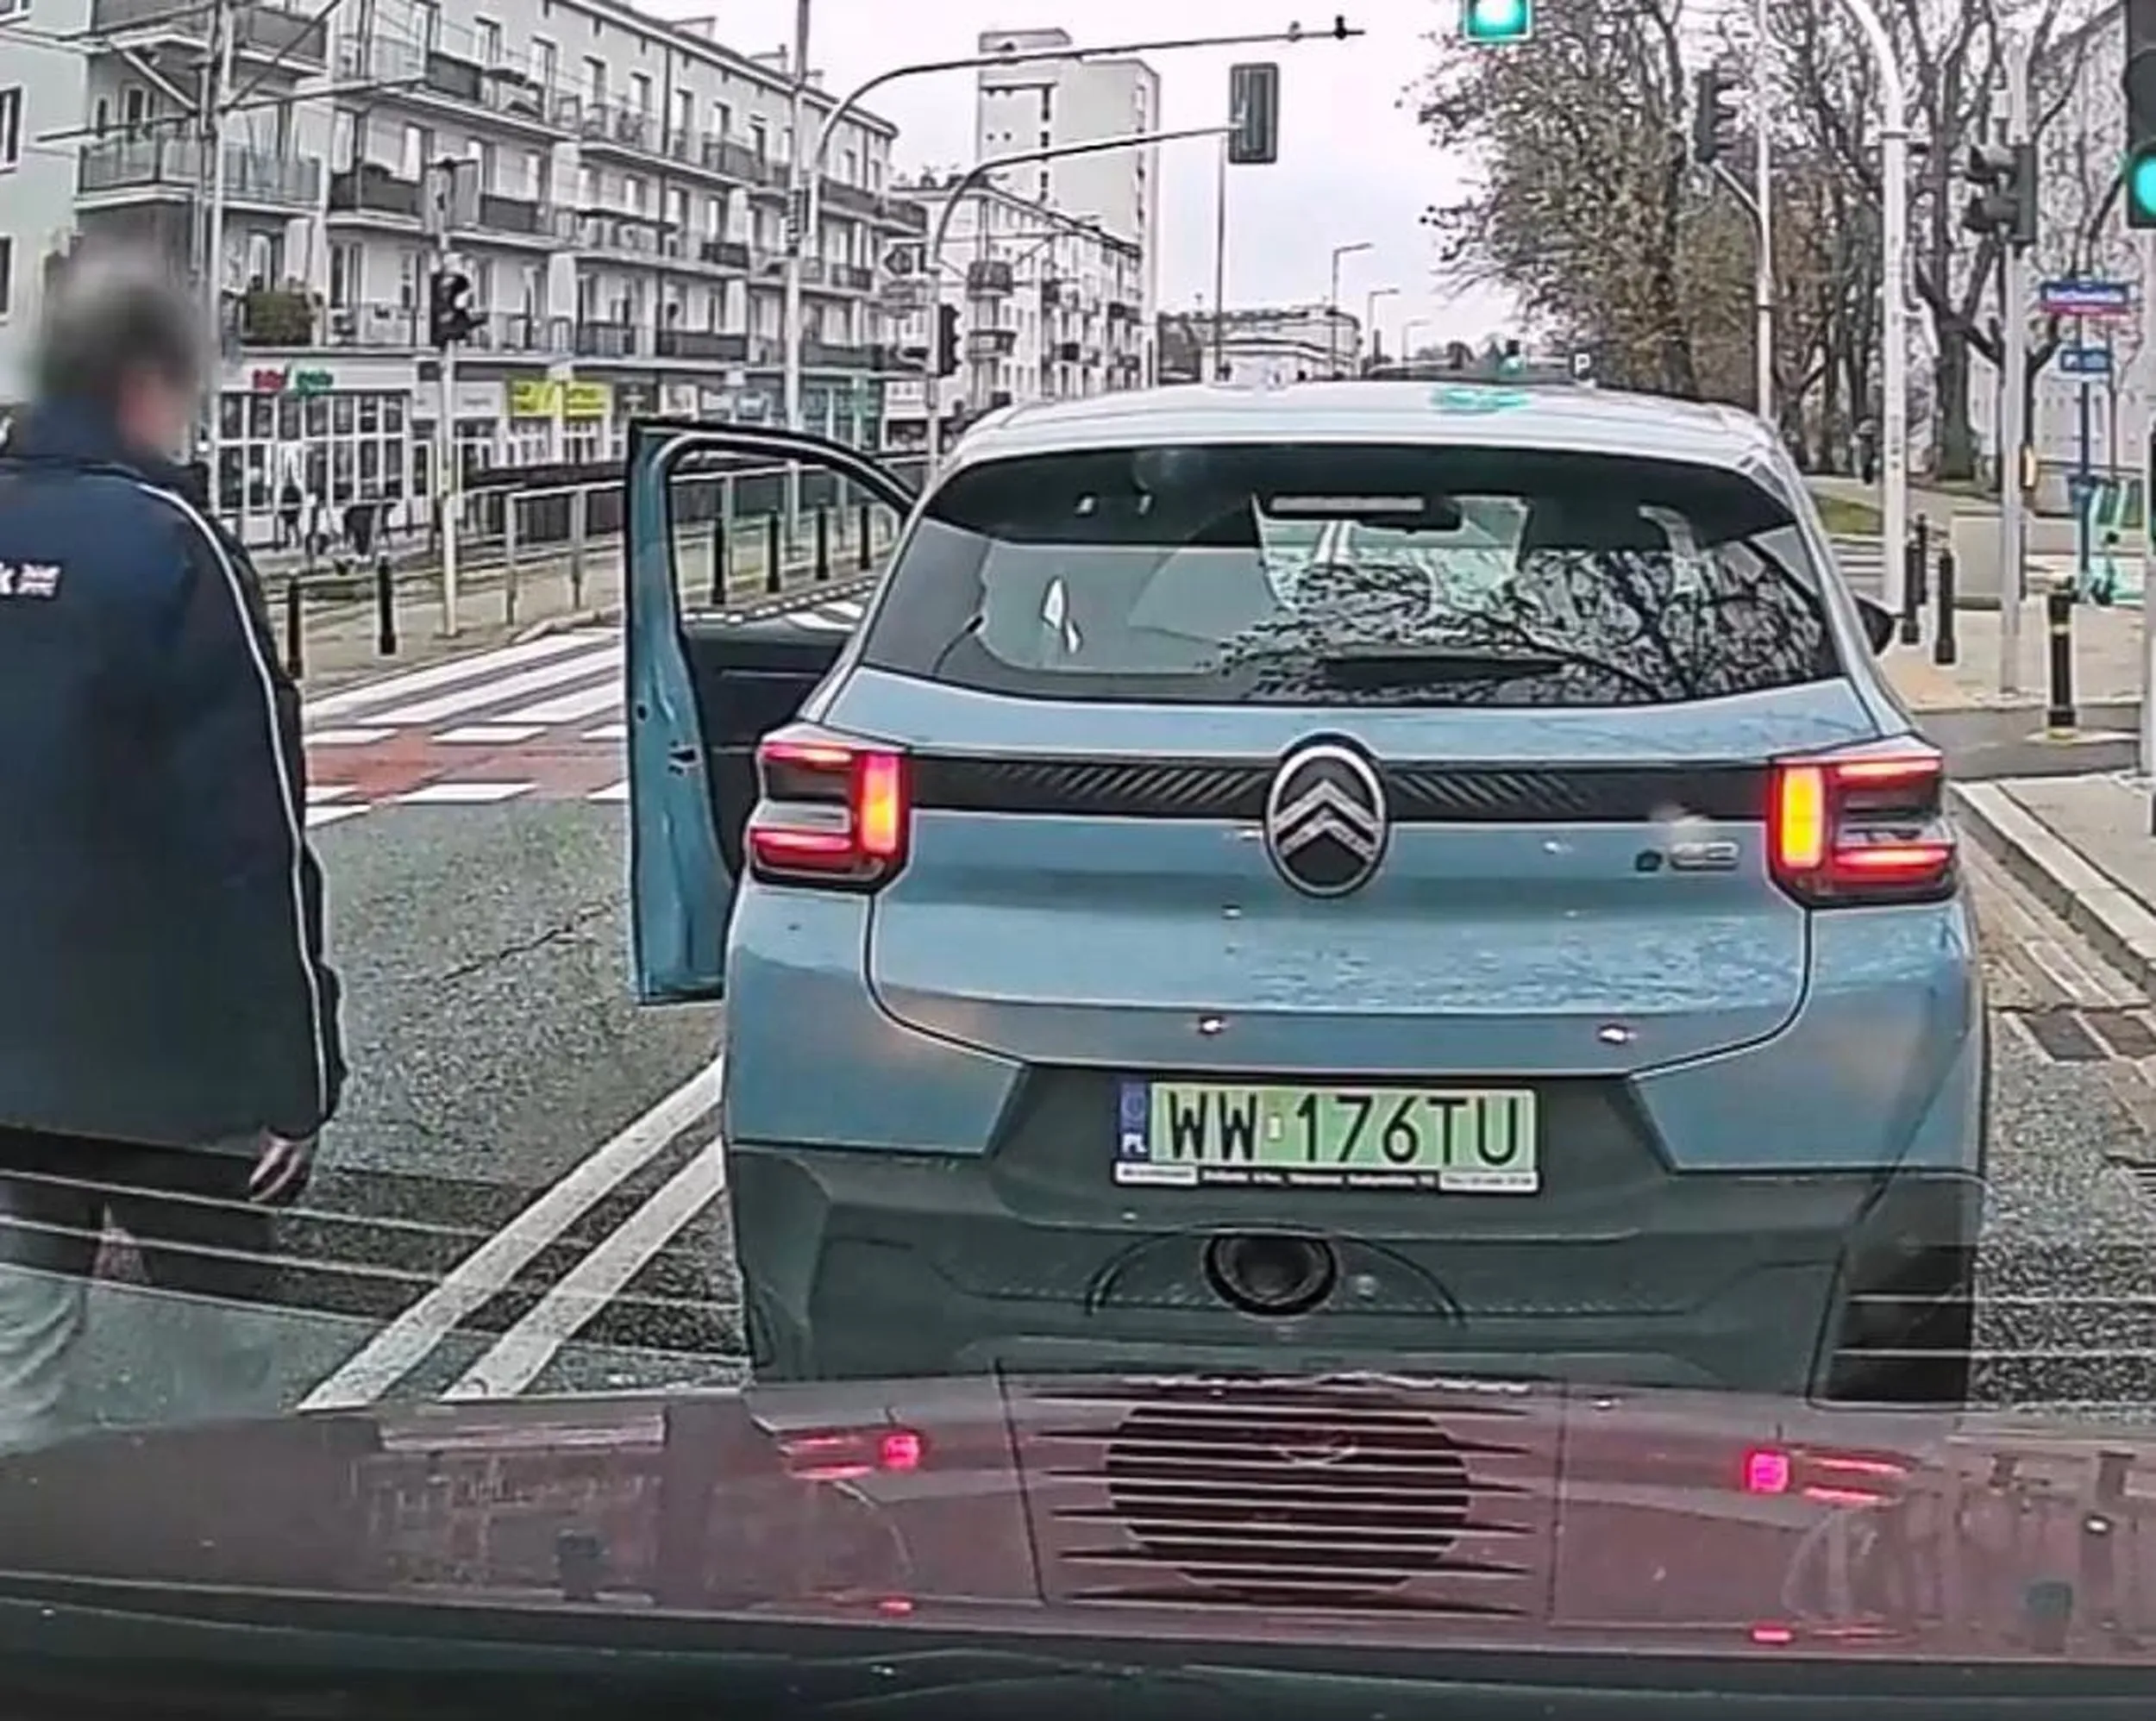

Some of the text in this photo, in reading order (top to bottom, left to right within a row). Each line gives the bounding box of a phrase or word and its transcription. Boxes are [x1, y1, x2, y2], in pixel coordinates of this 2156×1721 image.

[1122, 1132, 1147, 1154] PL
[1169, 1091, 1520, 1166] WW 176TU
